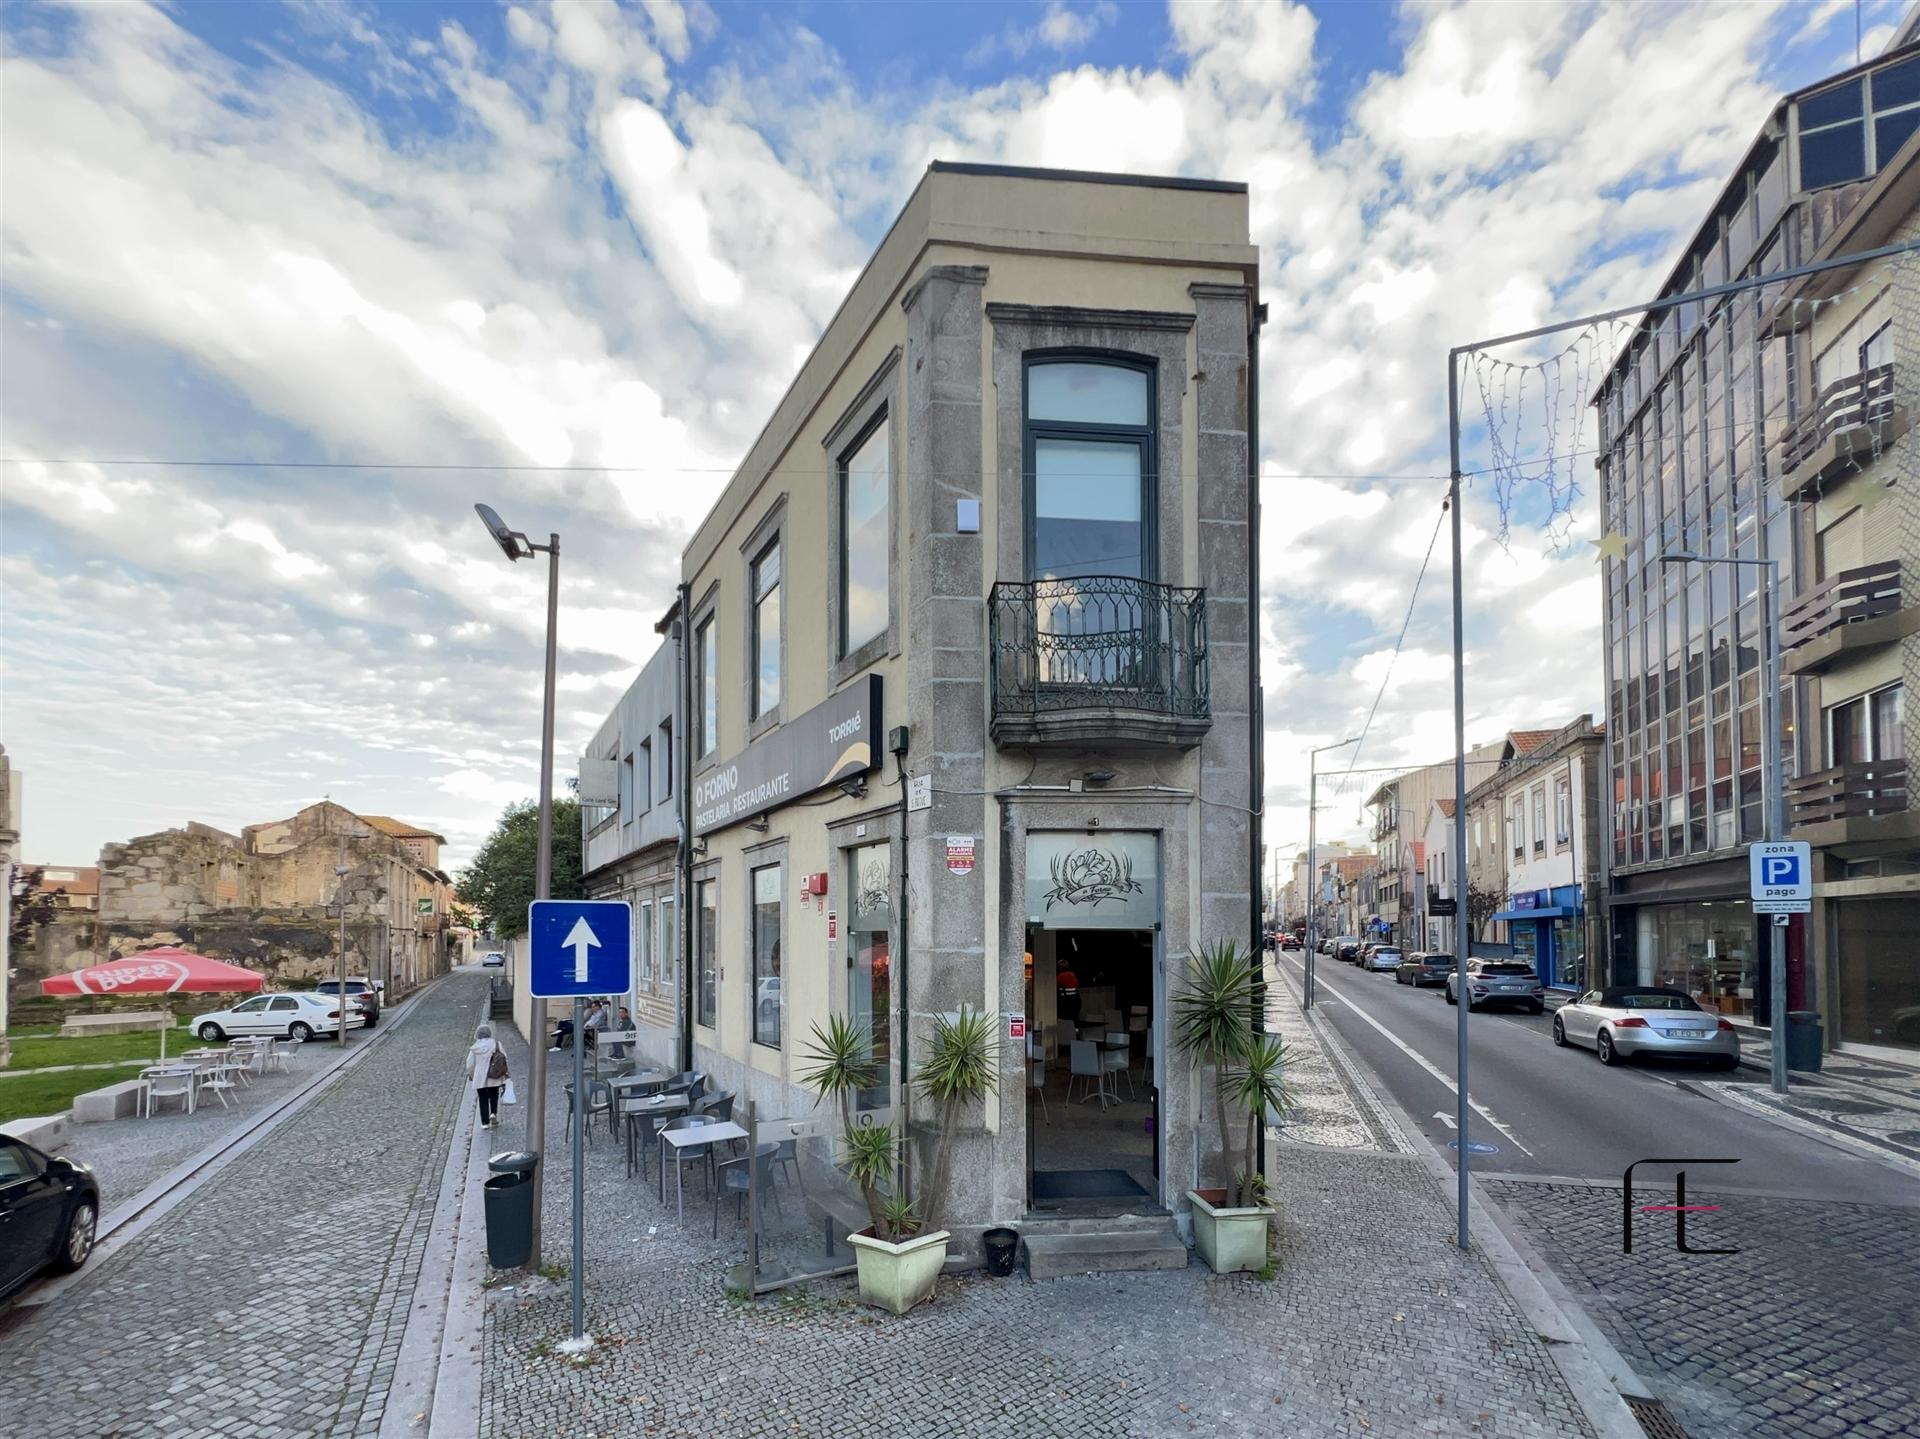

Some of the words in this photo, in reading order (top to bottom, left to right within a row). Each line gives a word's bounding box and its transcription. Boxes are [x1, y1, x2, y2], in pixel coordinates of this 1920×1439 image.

[696, 786, 703, 808] O
[704, 765, 738, 804] FORNO
[695, 801, 731, 830] PASTELARIA
[733, 772, 789, 814] RESTAURANTE
[1768, 858, 1793, 884] P
[1766, 888, 1796, 897] pago
[87, 963, 170, 979] SUPER
[97, 971, 175, 991] BOCK
